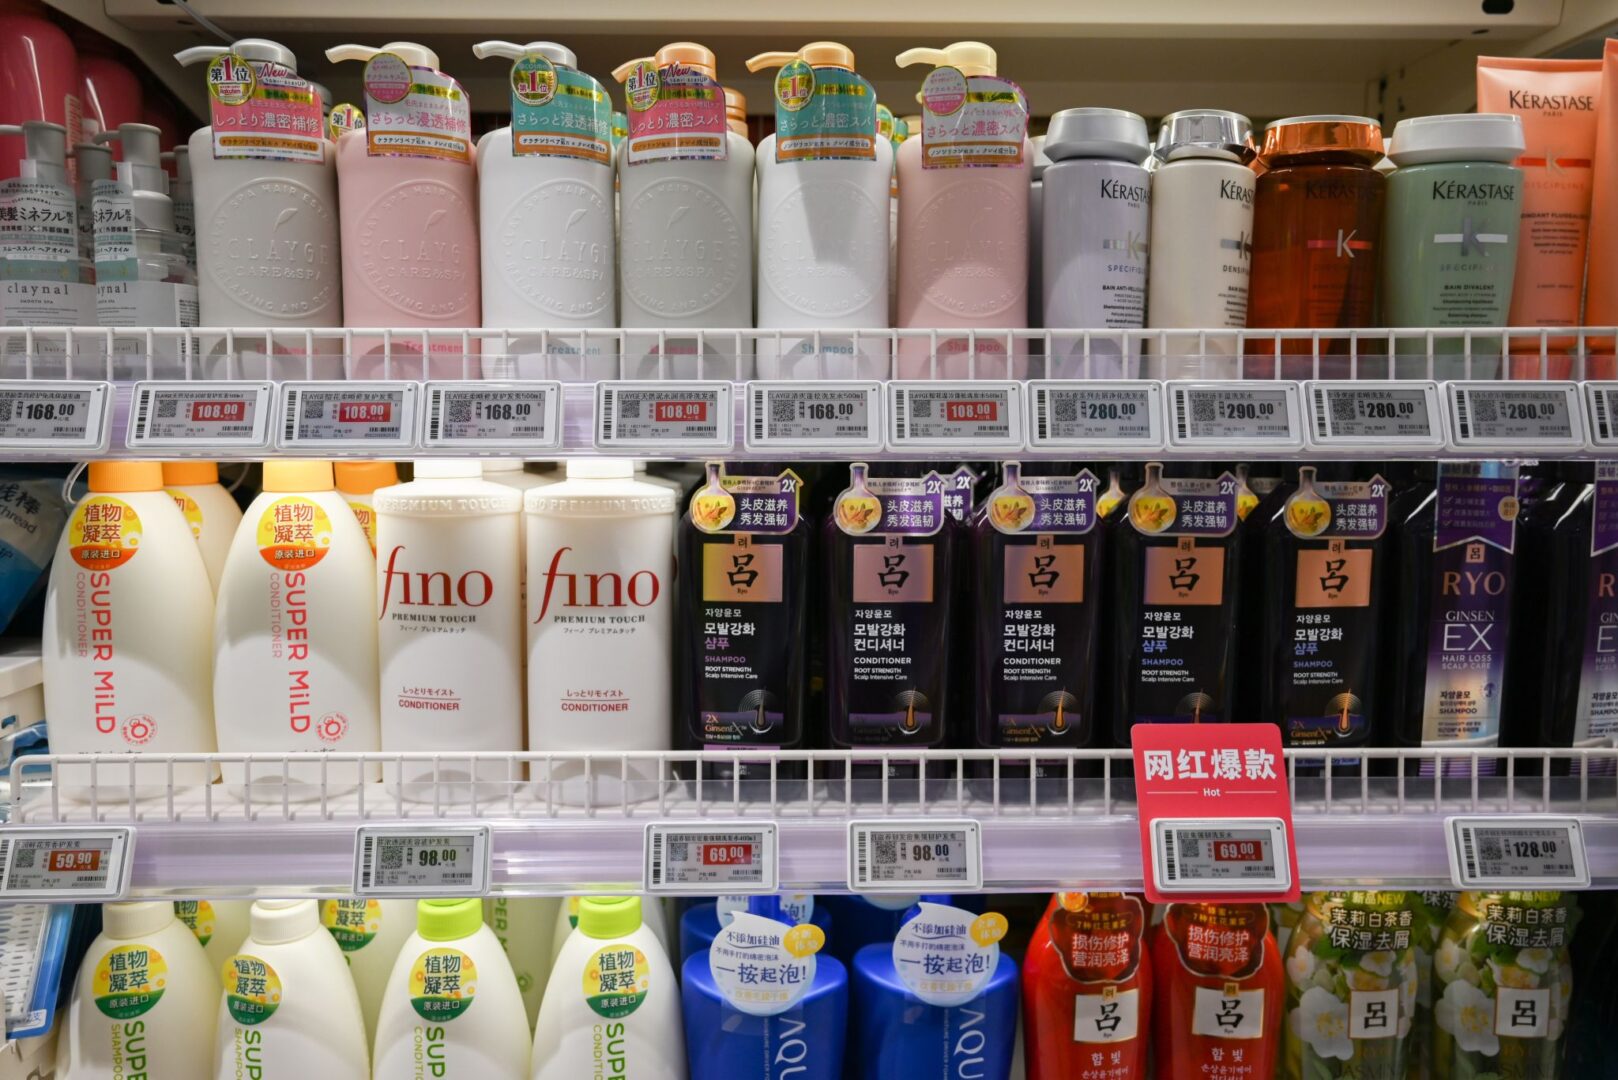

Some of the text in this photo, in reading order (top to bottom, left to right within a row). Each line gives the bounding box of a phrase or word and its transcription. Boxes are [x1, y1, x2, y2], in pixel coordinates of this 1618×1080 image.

[211, 56, 248, 81] 第1位
[257, 63, 288, 78] New
[663, 64, 691, 80] New
[628, 64, 656, 91] 第1位
[1509, 90, 1594, 112] KÉRASTASE
[216, 112, 319, 132] しっとり濃密補修
[372, 111, 466, 133] さらっと浸透補修
[927, 120, 1020, 138] さらっと濃密スパ
[1432, 180, 1516, 201] KÉRASTASE
[7, 284, 69, 296] claynal
[26, 403, 75, 420] 168.00
[197, 404, 238, 418] 108.00
[344, 405, 384, 420] 108.00
[484, 403, 531, 420] 168.00
[660, 404, 700, 419] 108.00
[808, 403, 854, 420] 168.00
[951, 404, 991, 418] 108.00
[1089, 402, 1136, 419] 280.00
[1227, 402, 1274, 419] 290.00
[1367, 402, 1414, 418] 280.00
[1508, 403, 1555, 419] 280.00
[781, 479, 796, 493] 2X
[926, 480, 942, 494] 2X
[956, 476, 970, 489] 2X
[1079, 478, 1094, 492] 2X
[1220, 481, 1235, 495] 2X
[740, 498, 788, 511] 头皮滋养
[887, 500, 934, 513] 头皮滋养
[1040, 498, 1087, 511] 头皮滋养
[1182, 500, 1227, 514] 头皮滋养
[1336, 504, 1378, 517] 头皮滋养
[84, 504, 122, 523] 植物
[274, 504, 313, 522] 植物
[740, 513, 788, 526] 秀发强韧
[887, 514, 934, 528] 秀发强韧
[1040, 513, 1087, 526] 秀发强韧
[1182, 515, 1227, 528] 秀发强韧
[1336, 518, 1378, 531] 秀发强韧
[82, 524, 122, 543] 凝萃
[274, 524, 314, 543] 凝萃
[81, 550, 121, 560] 原装进口
[275, 549, 315, 560] 原装进口
[379, 545, 494, 621] fino
[533, 547, 660, 624] fino
[1442, 571, 1505, 596] RYO
[76, 572, 88, 657] CONDITIONER
[91, 572, 113, 661] SUPER
[270, 572, 282, 659] CONDITIONER
[285, 572, 309, 661] SUPER
[392, 613, 477, 624] PREMIUM TOUCH
[554, 614, 646, 625] PREMIUM TOUCH
[705, 608, 742, 618] 자양윤모
[855, 609, 892, 619] 자양윤모
[1446, 610, 1495, 622] GINSEN
[704, 622, 755, 636] 모발강화
[853, 623, 906, 637] 모발강화
[1003, 624, 1056, 637] 모발강화
[1142, 626, 1194, 639] 모발강화
[1294, 628, 1343, 641] 모발강화
[1443, 623, 1493, 651] EX
[704, 637, 730, 650] 샴푸
[854, 638, 905, 652] 컨디셔너
[1003, 639, 1054, 652] 컨디셔너
[1142, 640, 1168, 653] 샴푸
[1294, 642, 1319, 655] 샴푸
[1442, 654, 1492, 662] HAIR LOSS
[402, 687, 455, 697] しっとりモイスト
[566, 688, 624, 698] しっとりモイスト
[398, 699, 460, 712] CONDITIONER
[561, 702, 629, 712] CONDITIONER
[1143, 748, 1277, 780] 网红爆款
[1203, 788, 1221, 797] Hot
[419, 849, 456, 866] 98.00
[710, 846, 744, 862] 69.00
[913, 844, 949, 861] 98.00
[1220, 843, 1254, 859] 69.00
[1513, 841, 1557, 858] 128.00
[56, 852, 92, 868] 59.90
[336, 910, 366, 927] 凝萃
[1331, 908, 1413, 927] 茉莉白茶香
[1487, 905, 1567, 924] 茉莉白茶香
[912, 923, 967, 935] 不添加硅油
[1188, 925, 1249, 945] 损伤修护
[1487, 924, 1565, 947] 保湿去屑
[727, 931, 780, 946] 不添加硅油
[1072, 933, 1129, 950] 损伤修护
[1331, 928, 1410, 950] 保湿去屑
[599, 950, 634, 971] 植物
[1072, 950, 1129, 967] 营润亮泽
[1187, 943, 1248, 962] 营润亮泽
[109, 950, 148, 972] 植物
[234, 960, 266, 977] 植物
[424, 955, 461, 974] 植物
[108, 970, 149, 993] 凝萃
[236, 977, 267, 997] 凝萃
[423, 975, 460, 995] 凝萃
[599, 970, 635, 992] 凝萃
[109, 996, 149, 1009] 原装进口
[233, 1000, 263, 1013] 原装进口
[423, 1001, 460, 1011] 原装进口
[601, 996, 636, 1008] 原装进口
[1364, 1001, 1387, 1029] 呂
[1512, 1000, 1536, 1027] 呂
